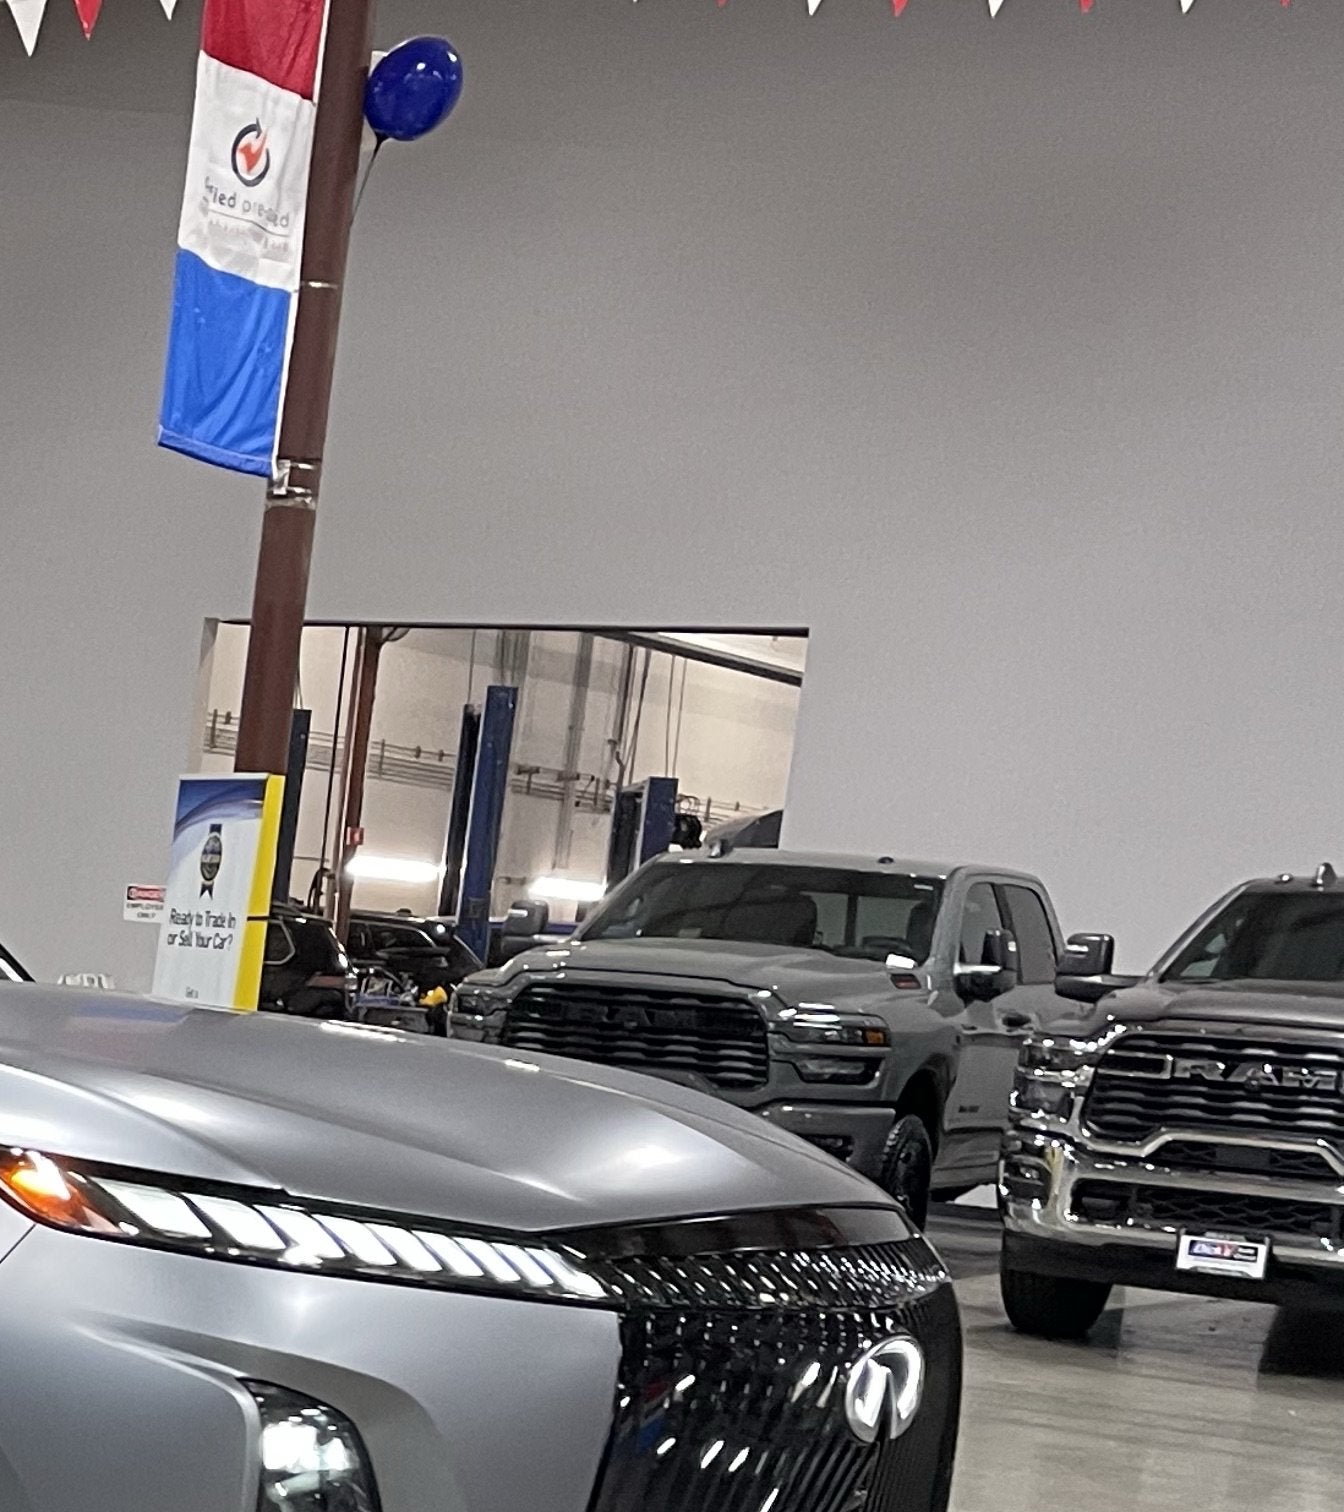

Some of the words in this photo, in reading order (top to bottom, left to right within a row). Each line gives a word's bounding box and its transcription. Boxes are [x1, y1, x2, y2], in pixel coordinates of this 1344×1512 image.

[170, 908, 193, 929] Ready
[195, 911, 203, 926] to
[205, 910, 226, 928] Trade
[227, 911, 236, 929] In
[167, 933, 178, 945] or
[178, 930, 193, 947] Sell
[195, 931, 212, 948] Your
[213, 933, 233, 951] Car?
[1174, 1058, 1337, 1090] RAM
